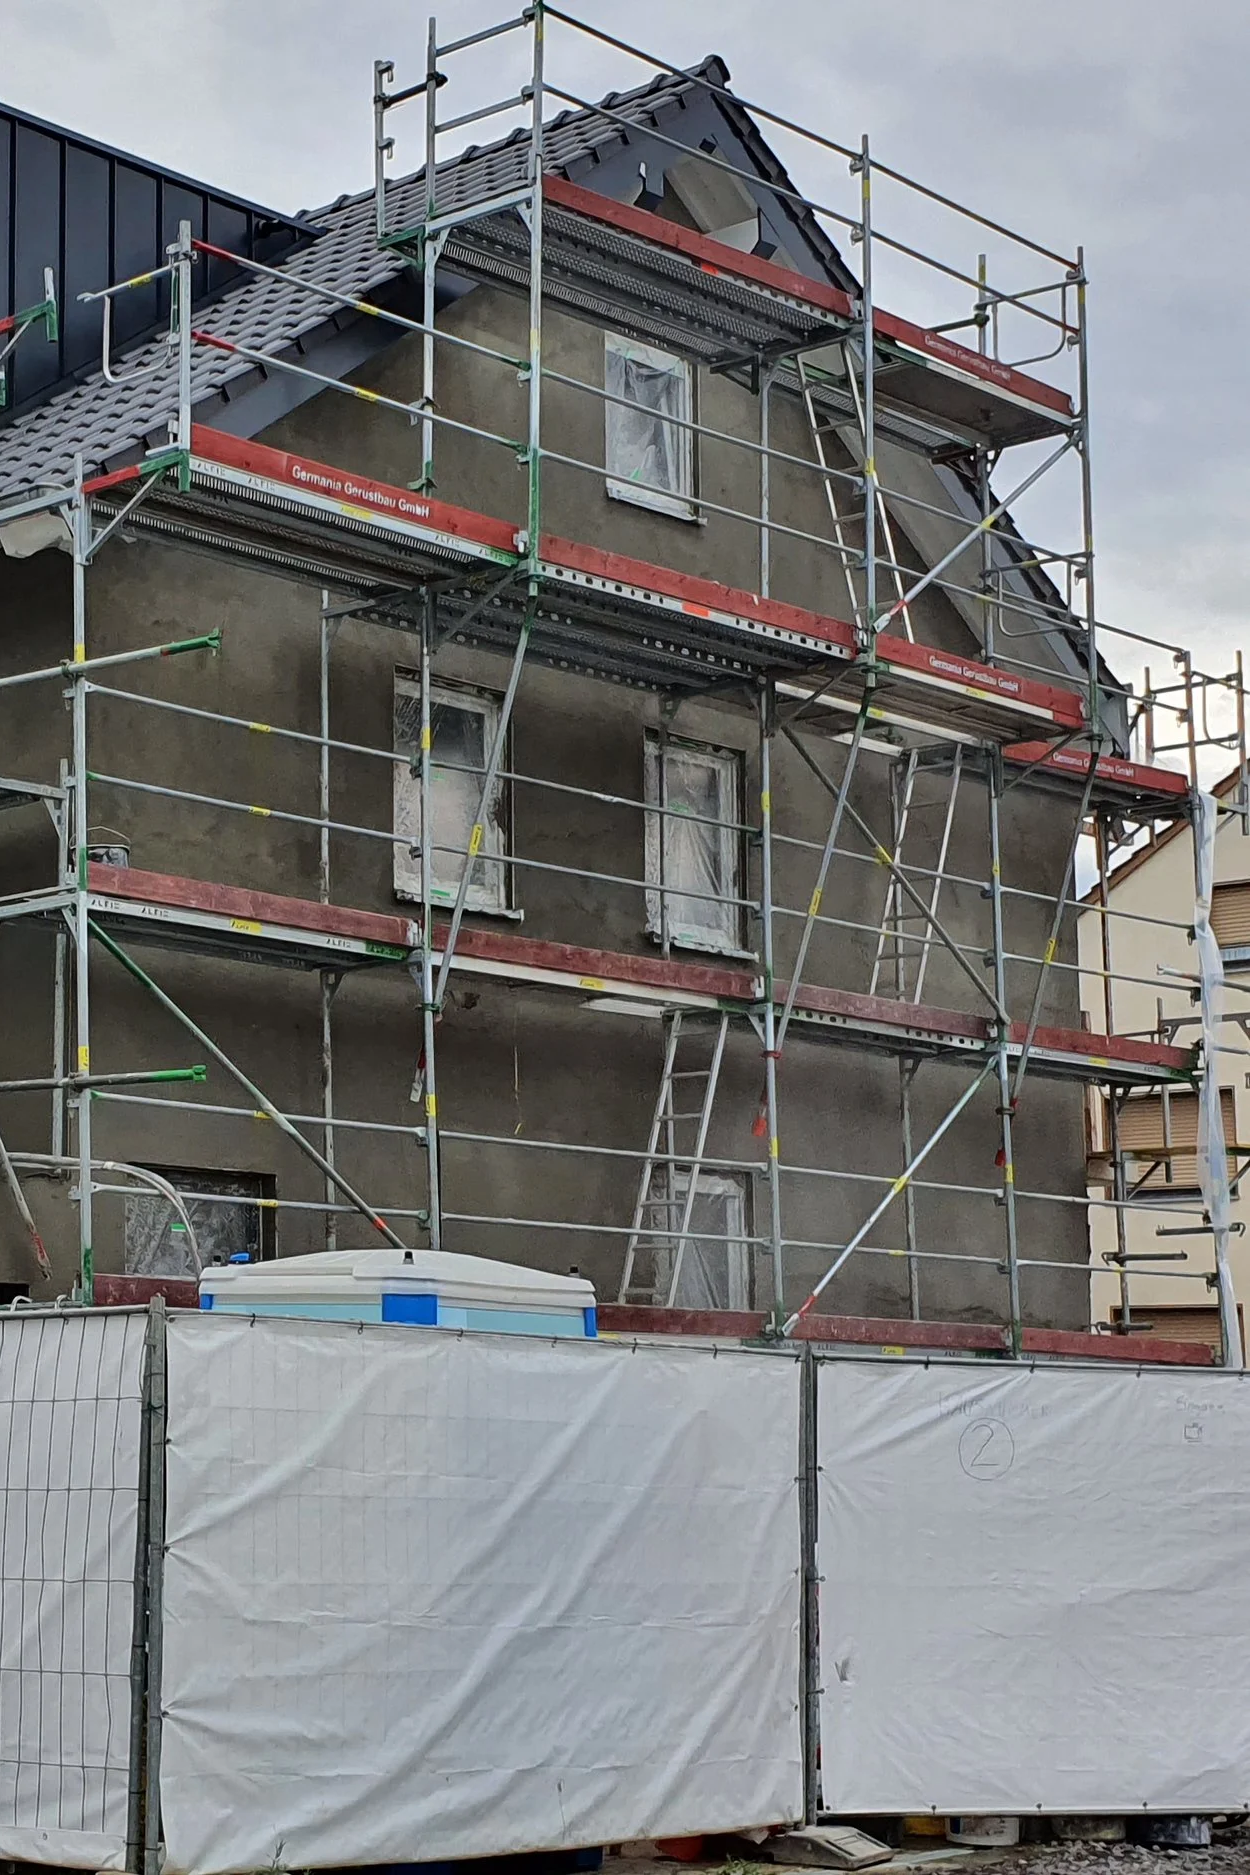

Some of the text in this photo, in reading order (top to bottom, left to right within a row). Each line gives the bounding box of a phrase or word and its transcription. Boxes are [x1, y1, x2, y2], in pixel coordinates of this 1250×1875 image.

[292, 465, 342, 491] Germania
[398, 498, 430, 518] GmbH
[971, 1423, 1000, 1468] 2
